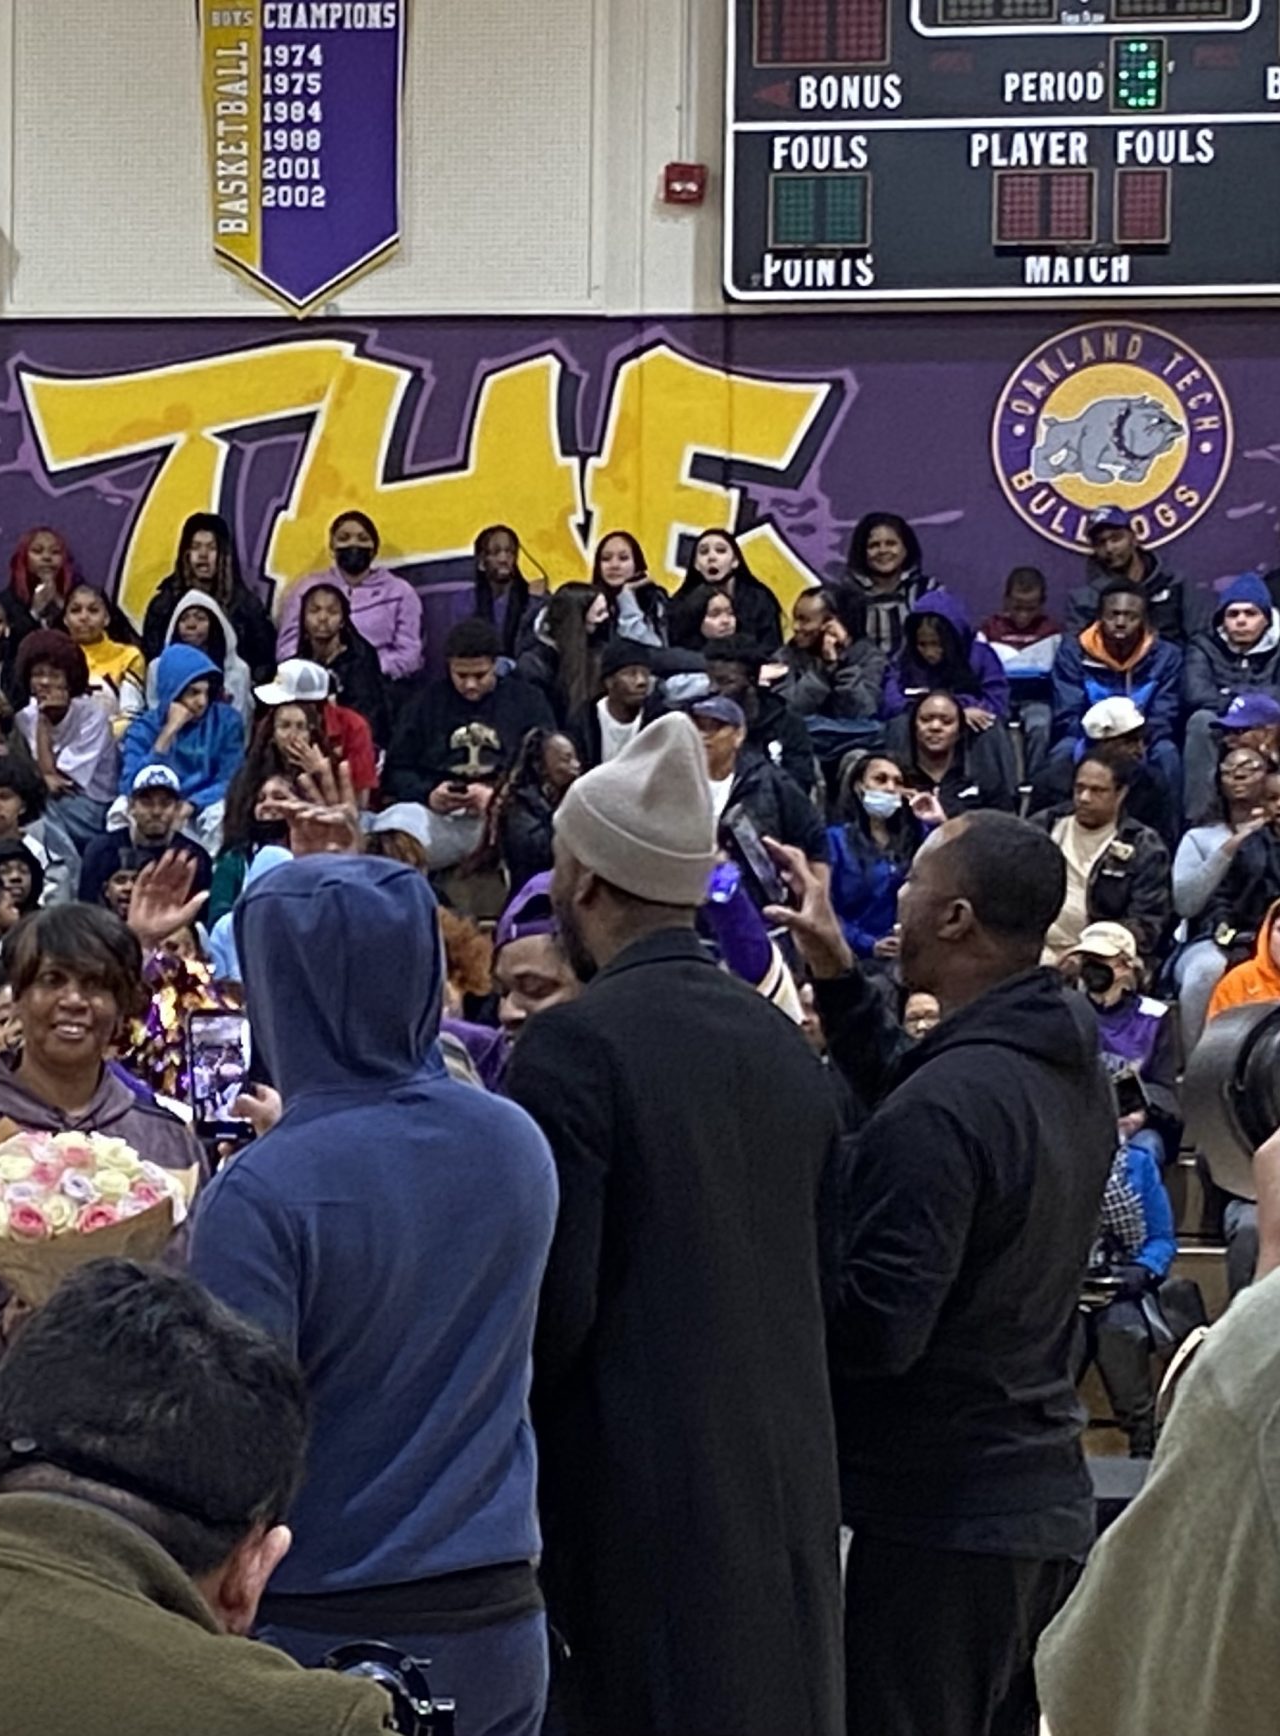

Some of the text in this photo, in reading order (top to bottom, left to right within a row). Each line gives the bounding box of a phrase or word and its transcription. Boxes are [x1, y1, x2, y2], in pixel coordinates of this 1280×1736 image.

[211, 10, 254, 27] BOYS
[262, 2, 397, 29] CHAMPIONS
[263, 43, 323, 67] 1974
[263, 72, 322, 95] 1975
[798, 73, 903, 110] BONUS
[1004, 71, 1105, 102] PERIOD
[263, 100, 323, 123] 1984
[216, 40, 250, 235] BASKETBALL
[263, 128, 322, 152] 1988
[773, 135, 869, 170] FOULS
[970, 128, 1215, 168] PLAYER FOULS
[262, 156, 321, 180] 2001
[262, 185, 326, 208] 2002
[763, 252, 875, 288] POINTS
[1010, 331, 1221, 431] OAKLAND TECH
[18, 338, 834, 640] THE
[1010, 469, 1200, 542] BULLOGS
